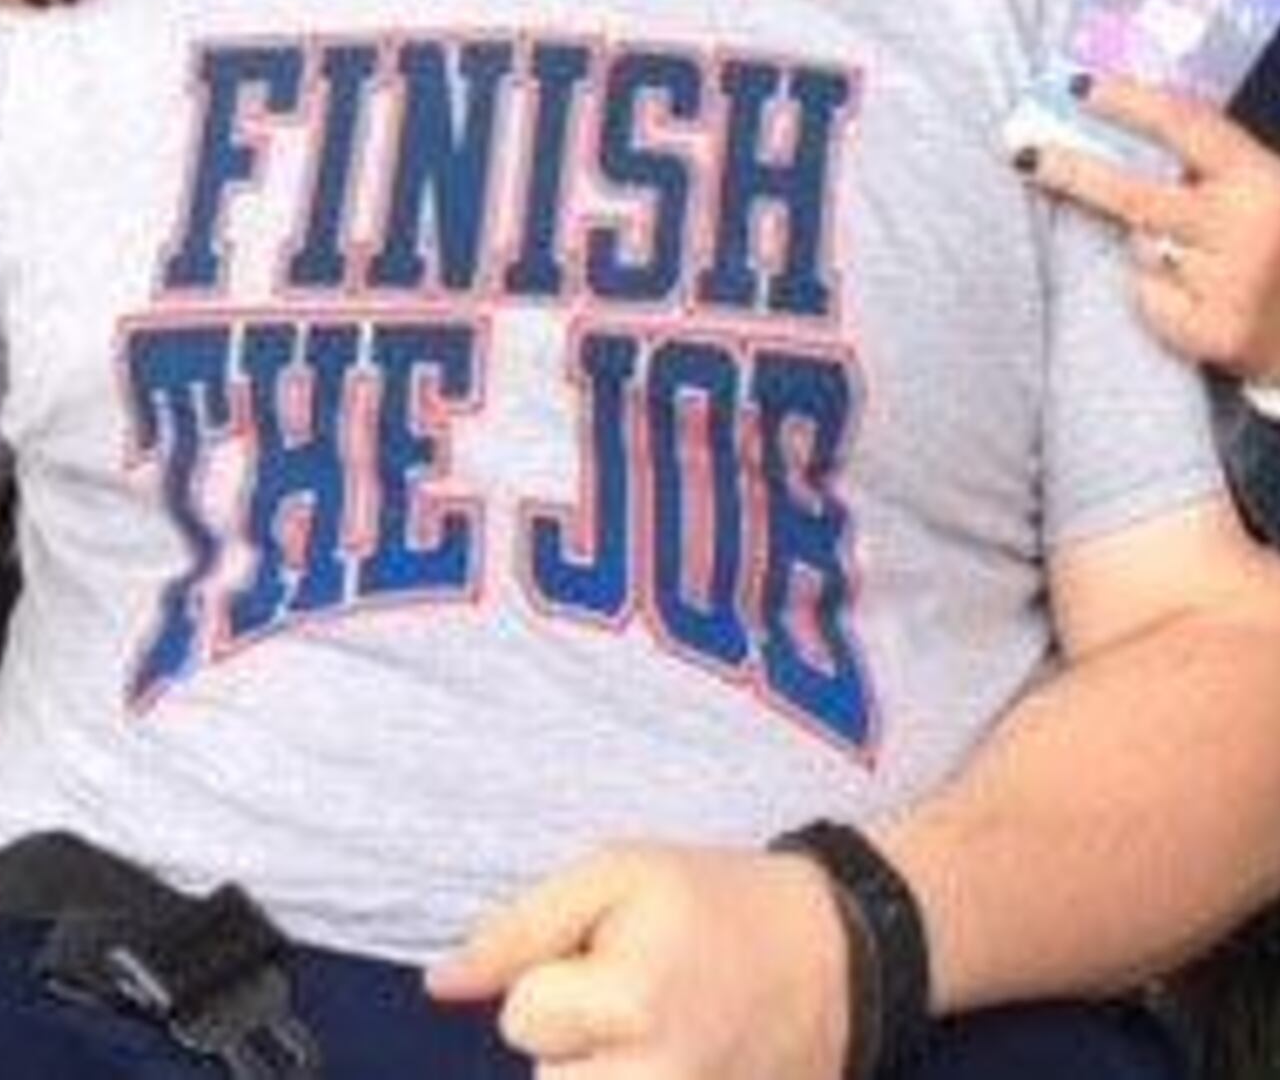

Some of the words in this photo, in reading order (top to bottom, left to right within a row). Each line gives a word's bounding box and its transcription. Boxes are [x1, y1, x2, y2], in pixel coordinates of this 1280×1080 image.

[154, 28, 860, 316] FINISH
[117, 314, 486, 718] THE
[518, 318, 876, 768] JOB
